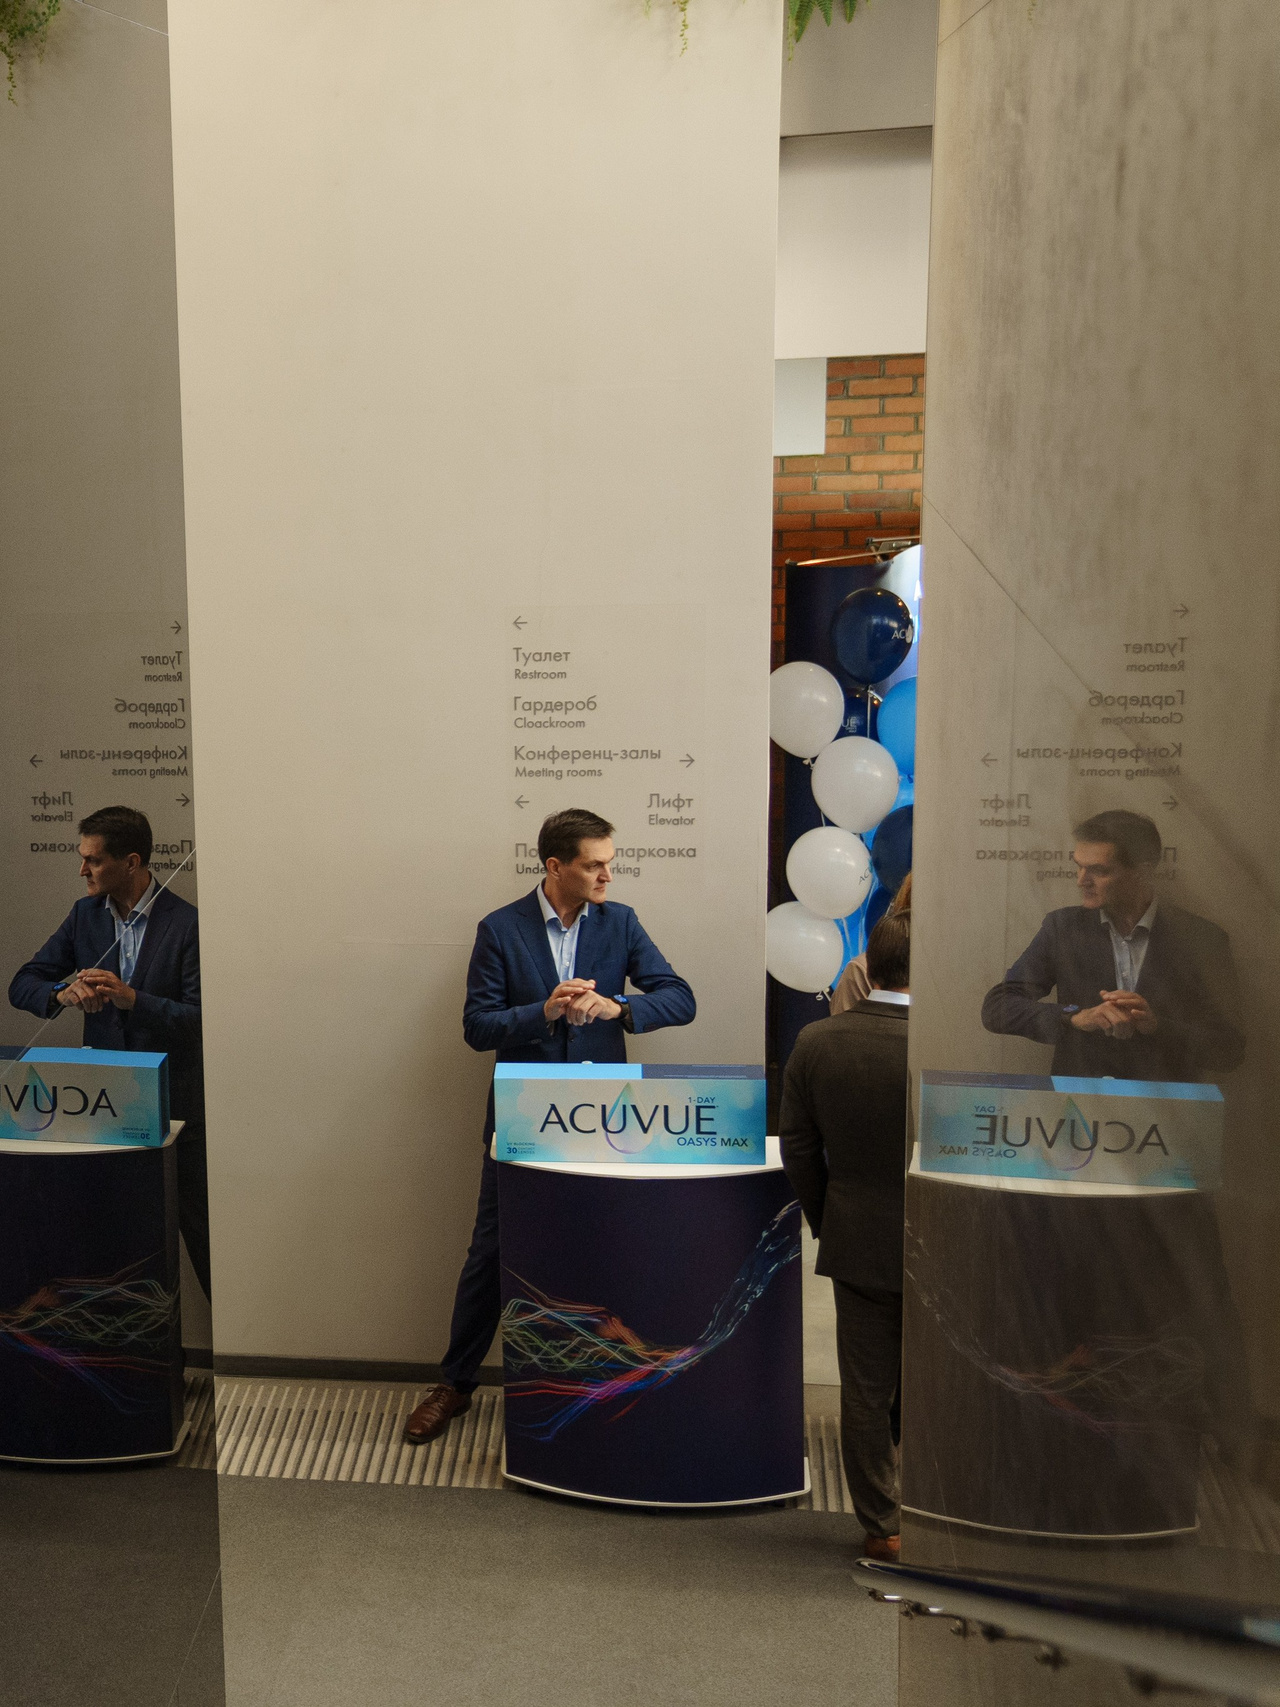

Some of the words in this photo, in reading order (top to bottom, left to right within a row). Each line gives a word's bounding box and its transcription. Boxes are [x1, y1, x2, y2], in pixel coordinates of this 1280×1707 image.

[513, 647, 571, 666] Туалет
[514, 669, 567, 680] Restroom
[513, 695, 597, 715] Гардероб
[514, 717, 586, 729] Cloackroom
[514, 745, 661, 764] Конференц-залы
[515, 767, 563, 780] Meeting
[567, 768, 602, 778] rooms
[647, 793, 694, 812] Лифт
[648, 814, 695, 826] Elevator
[688, 1096, 716, 1104] 1-DAY
[539, 1103, 718, 1135] ACUVUE
[676, 1136, 717, 1147] OASYS
[720, 1137, 748, 1147] MAX
[506, 1146, 518, 1154] 30
